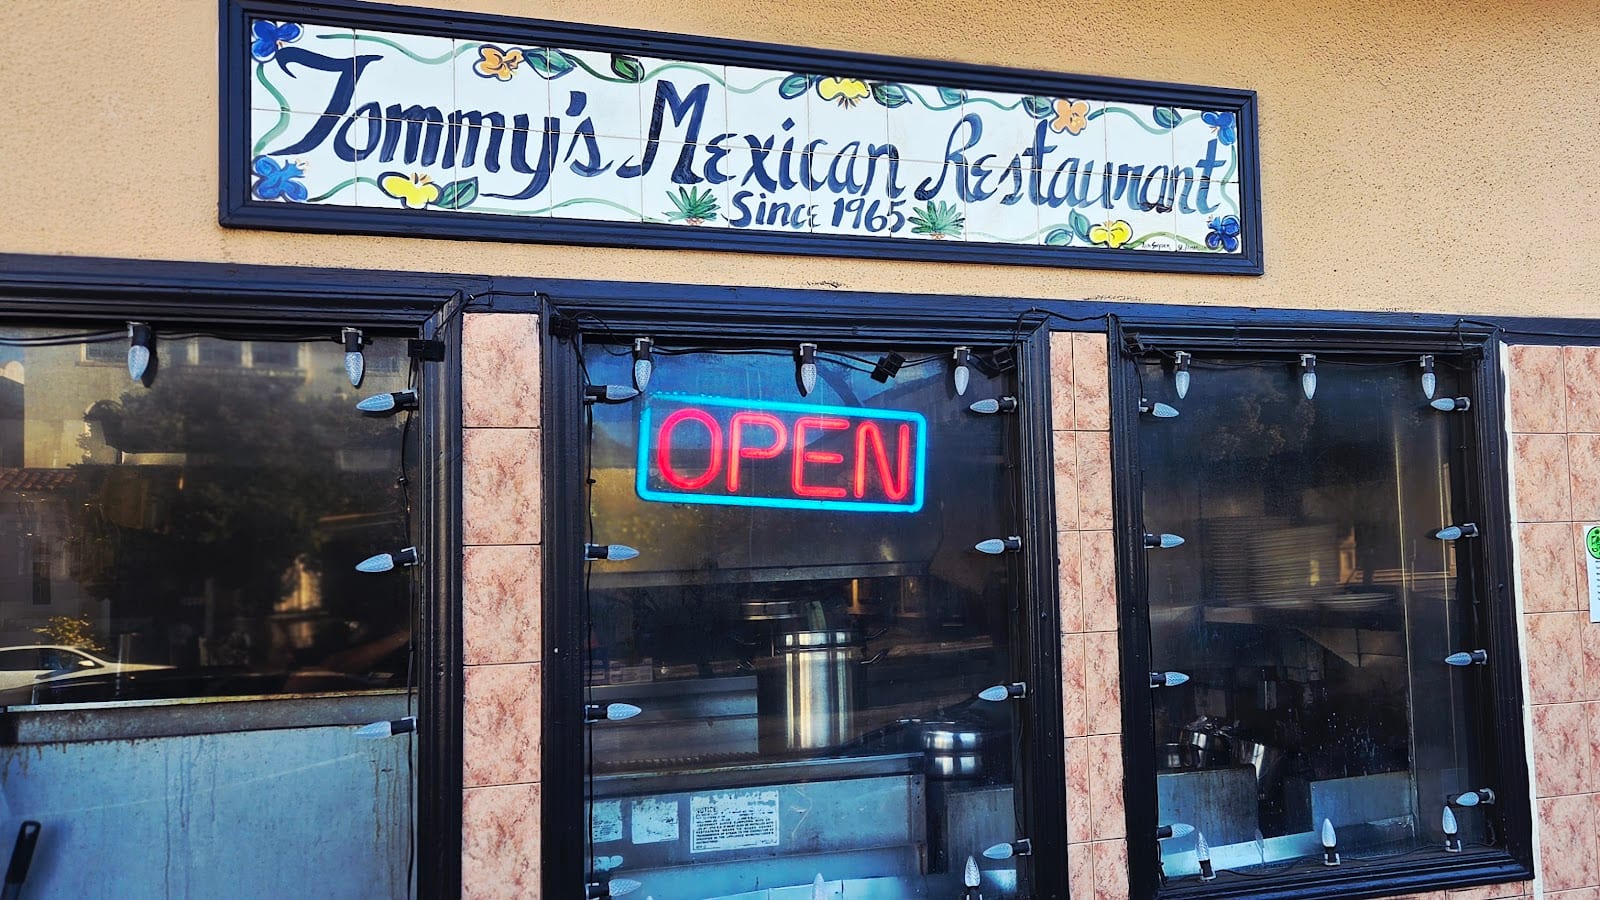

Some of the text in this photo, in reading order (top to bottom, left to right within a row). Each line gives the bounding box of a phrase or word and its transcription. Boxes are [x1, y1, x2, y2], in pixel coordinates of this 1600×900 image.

[270, 46, 1226, 214] Tommy's Mexican Restaurant
[720, 190, 907, 233] Since 1965
[657, 408, 910, 501] OPEN
